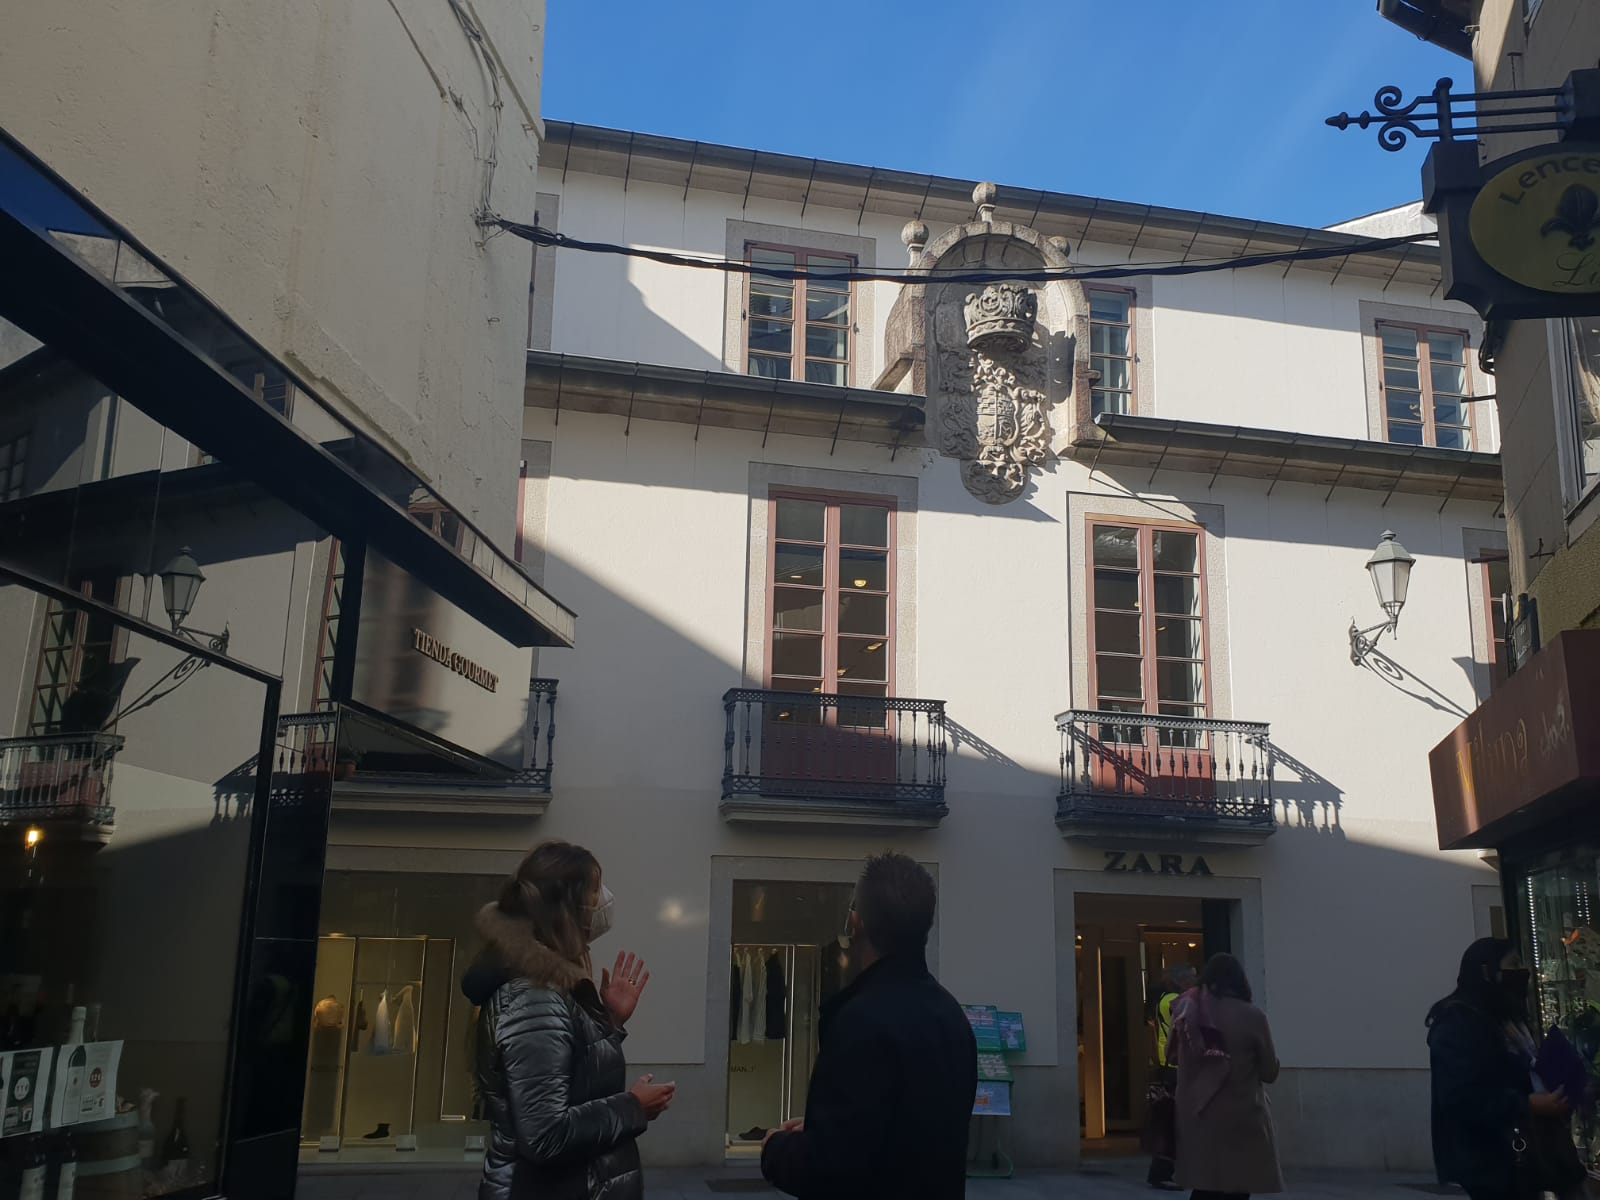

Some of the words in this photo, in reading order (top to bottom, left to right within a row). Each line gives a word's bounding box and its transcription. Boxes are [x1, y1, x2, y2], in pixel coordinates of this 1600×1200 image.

[414, 628, 452, 668] TIENDA
[450, 652, 499, 693] GOURMET
[1103, 850, 1216, 875] ZARA
